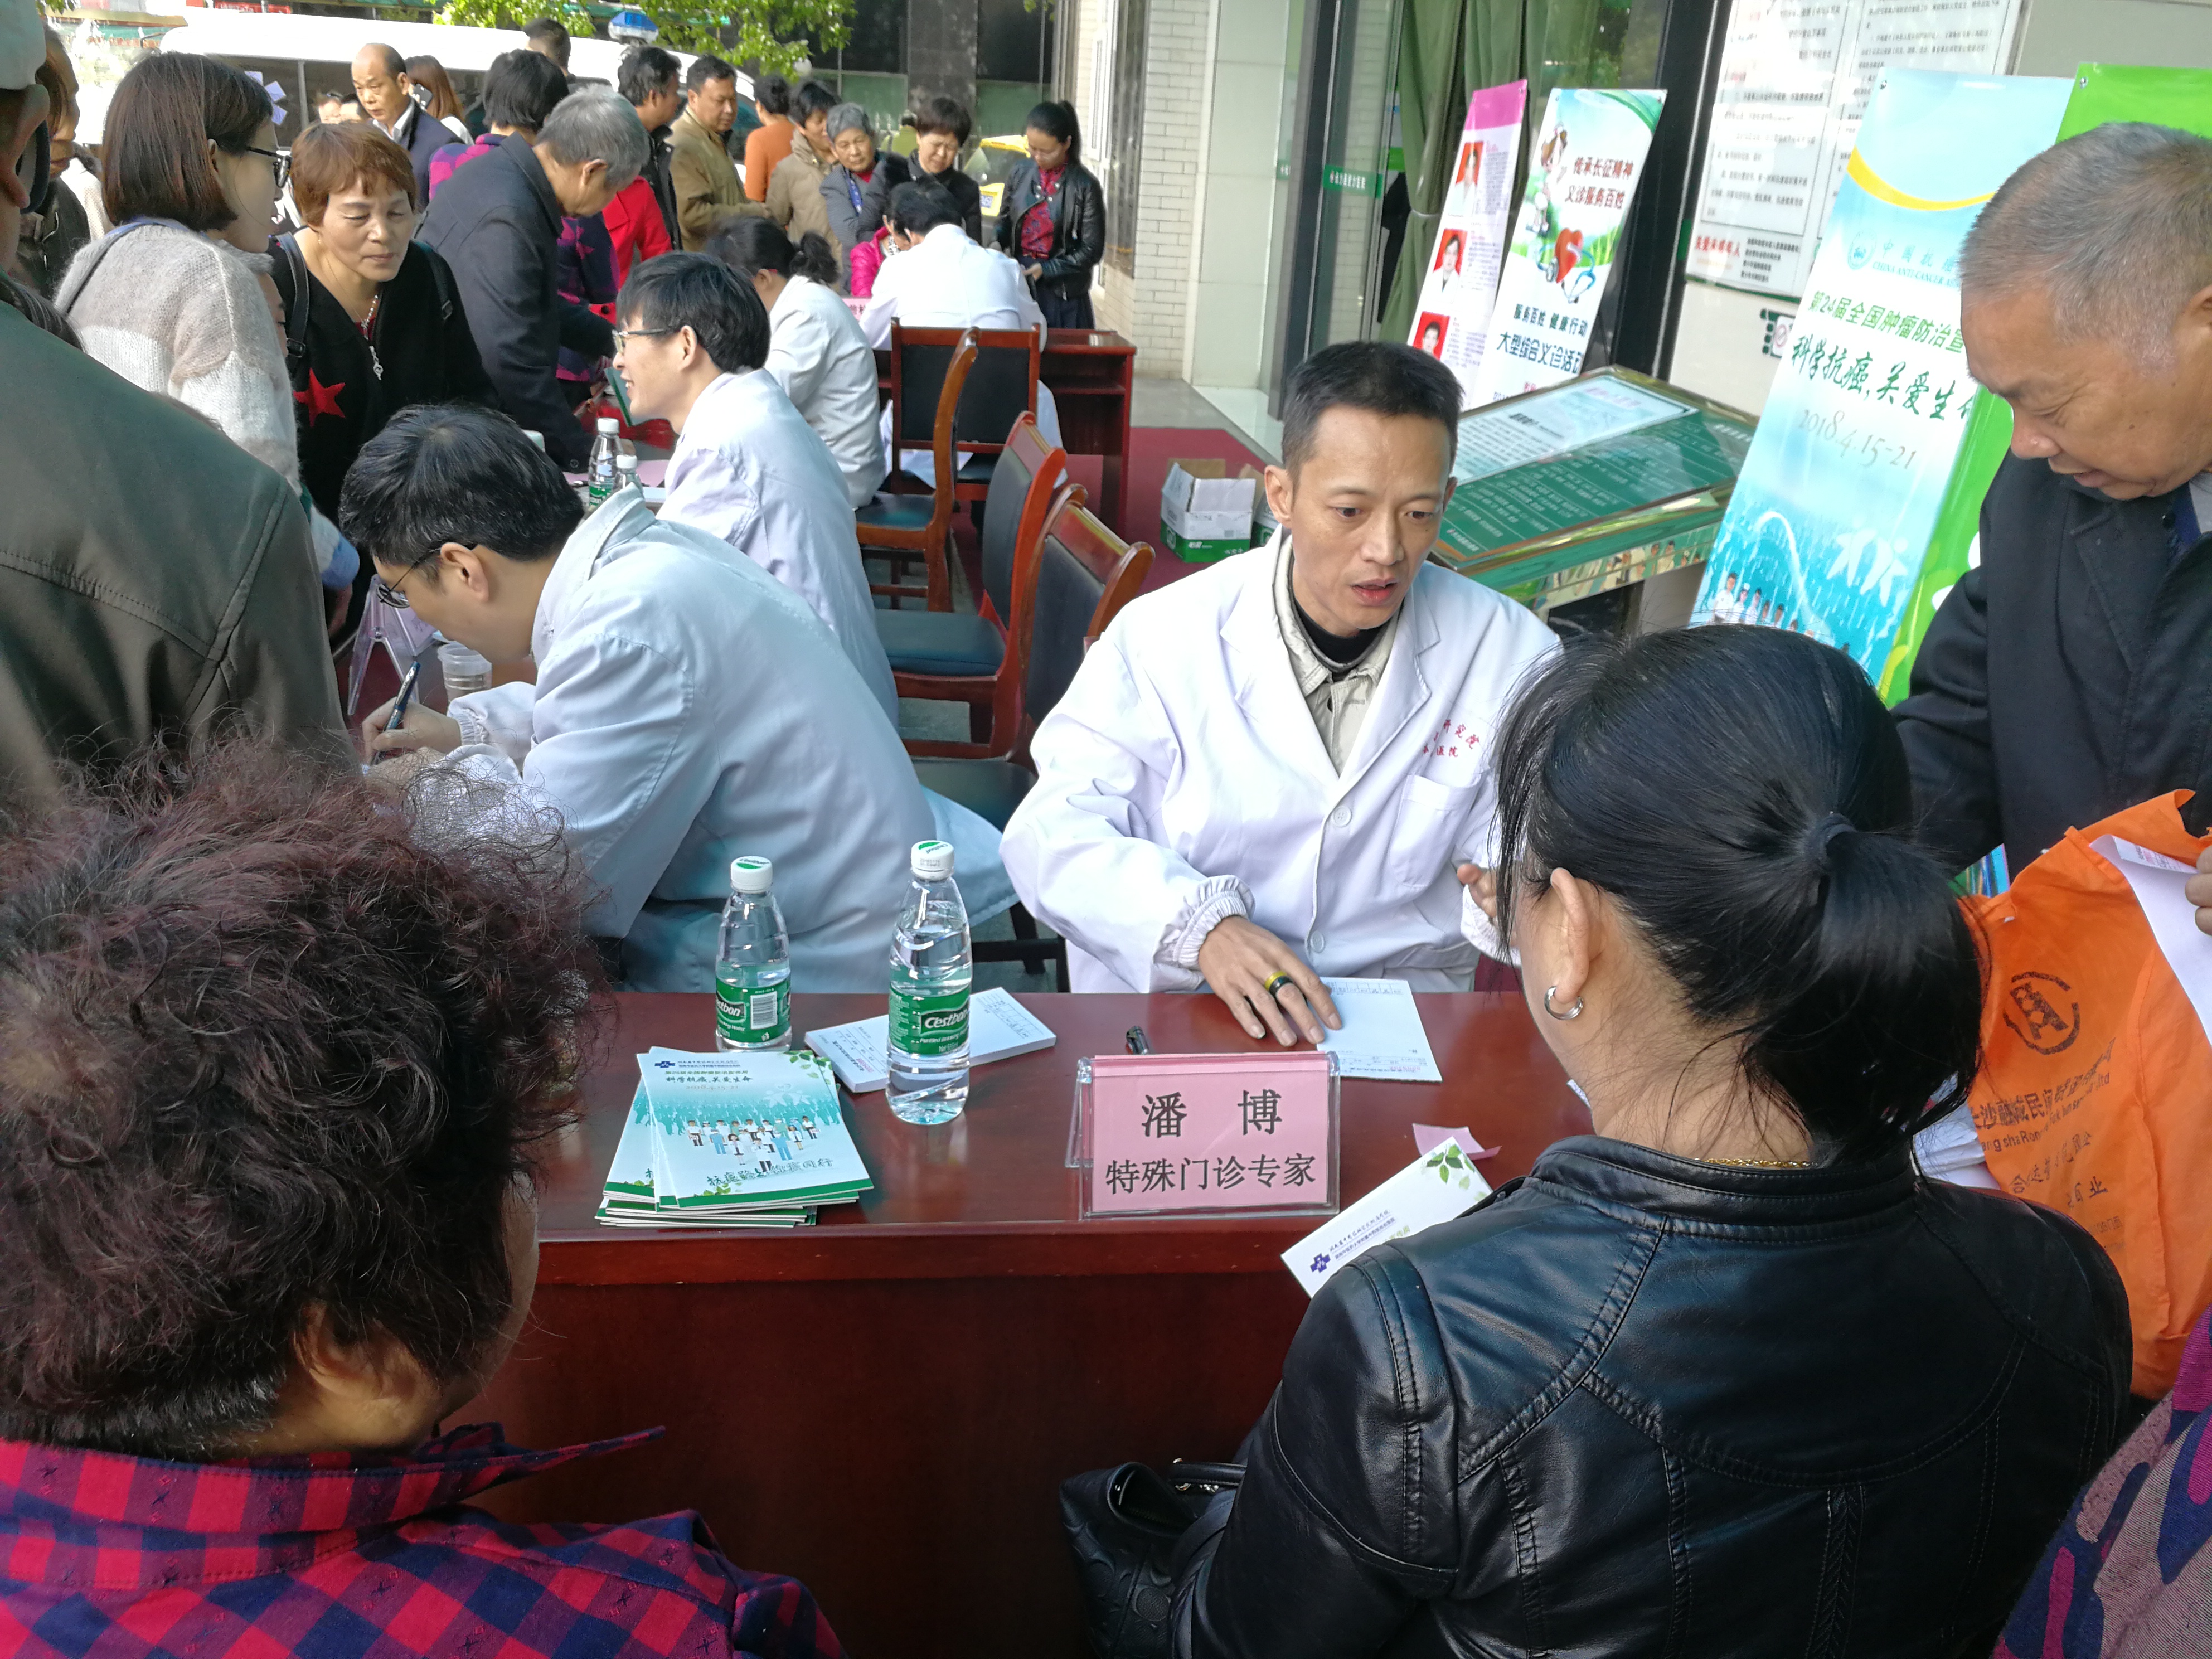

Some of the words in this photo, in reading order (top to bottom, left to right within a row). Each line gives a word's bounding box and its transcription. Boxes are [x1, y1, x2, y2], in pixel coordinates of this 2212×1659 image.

[1574, 157, 1634, 181] 传承长征精神
[1565, 185, 1625, 210] 义诊服务百姓
[1549, 313, 1588, 338] 健康行动
[1141, 1092, 1187, 1139] 潘
[1238, 1089, 1283, 1136] 博
[1105, 1152, 1316, 1195] 特殊门诊专家
